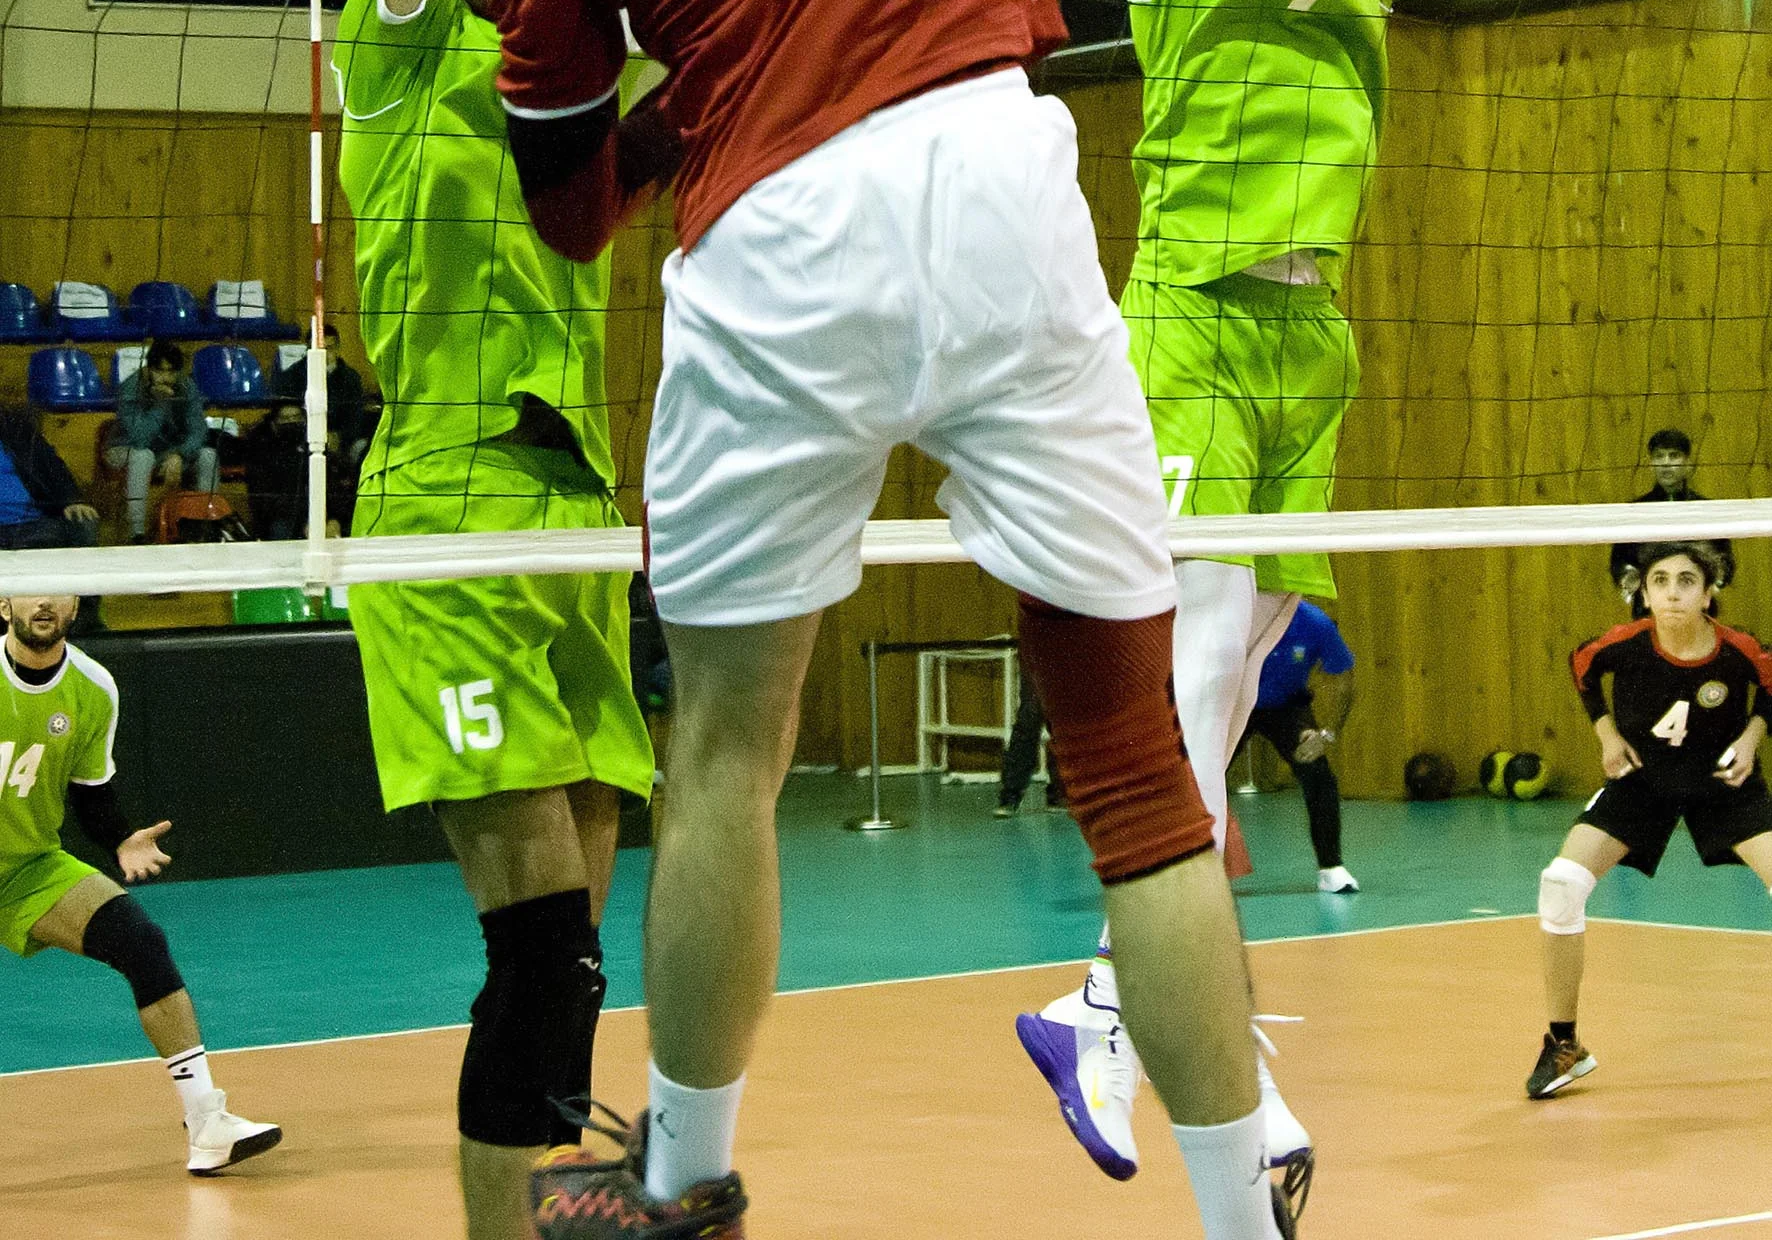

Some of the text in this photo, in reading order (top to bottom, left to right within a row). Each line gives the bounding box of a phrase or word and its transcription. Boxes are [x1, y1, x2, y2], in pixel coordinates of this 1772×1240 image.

[1162, 454, 1194, 519] 7
[438, 678, 504, 754] 15
[1650, 700, 1690, 747] 4
[0, 741, 45, 798] 14
